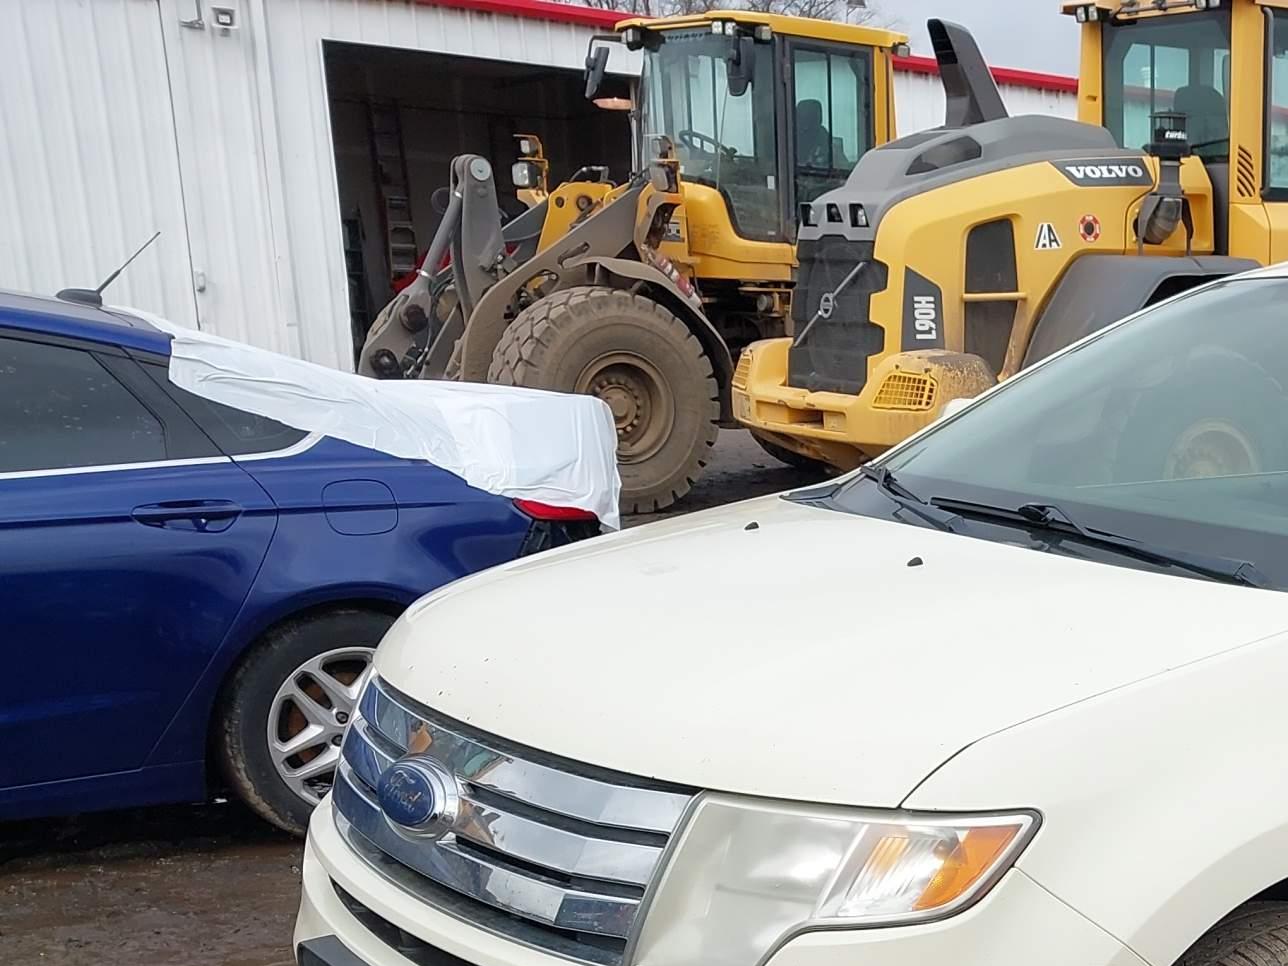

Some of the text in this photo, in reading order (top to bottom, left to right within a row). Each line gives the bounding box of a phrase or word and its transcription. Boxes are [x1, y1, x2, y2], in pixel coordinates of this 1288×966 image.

[1065, 165, 1144, 179] VOLVO
[913, 295, 937, 340] L90H
[383, 769, 423, 813] Ford
